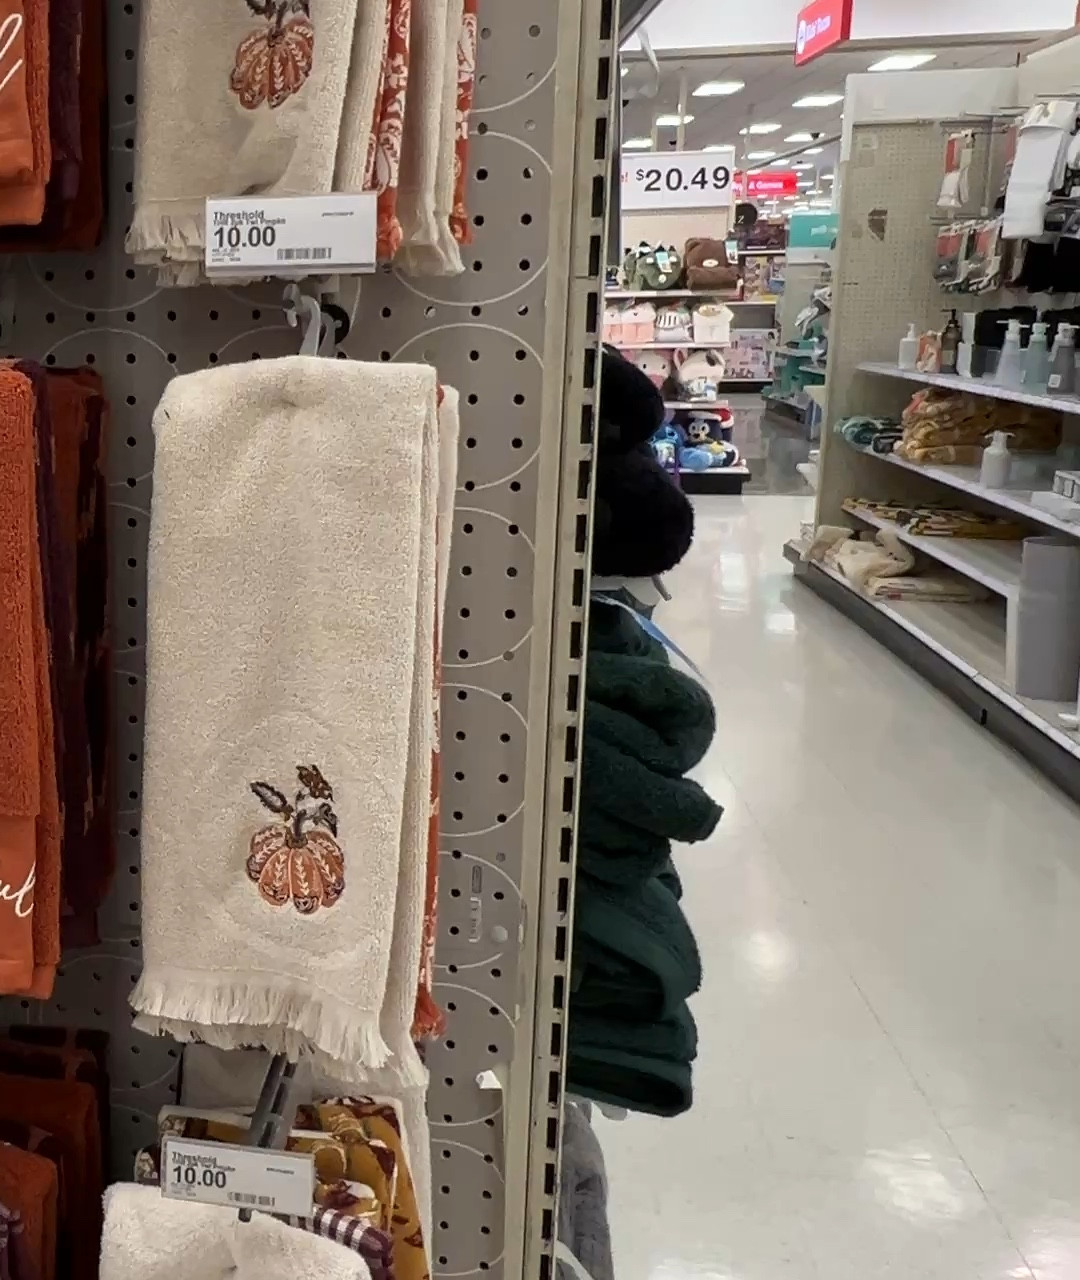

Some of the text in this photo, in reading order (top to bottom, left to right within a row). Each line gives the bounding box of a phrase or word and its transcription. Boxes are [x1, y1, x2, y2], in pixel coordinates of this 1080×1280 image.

[635, 166, 730, 192] $20.49
[213, 226, 276, 248] 10.00
[173, 1165, 226, 1188] 10.00
